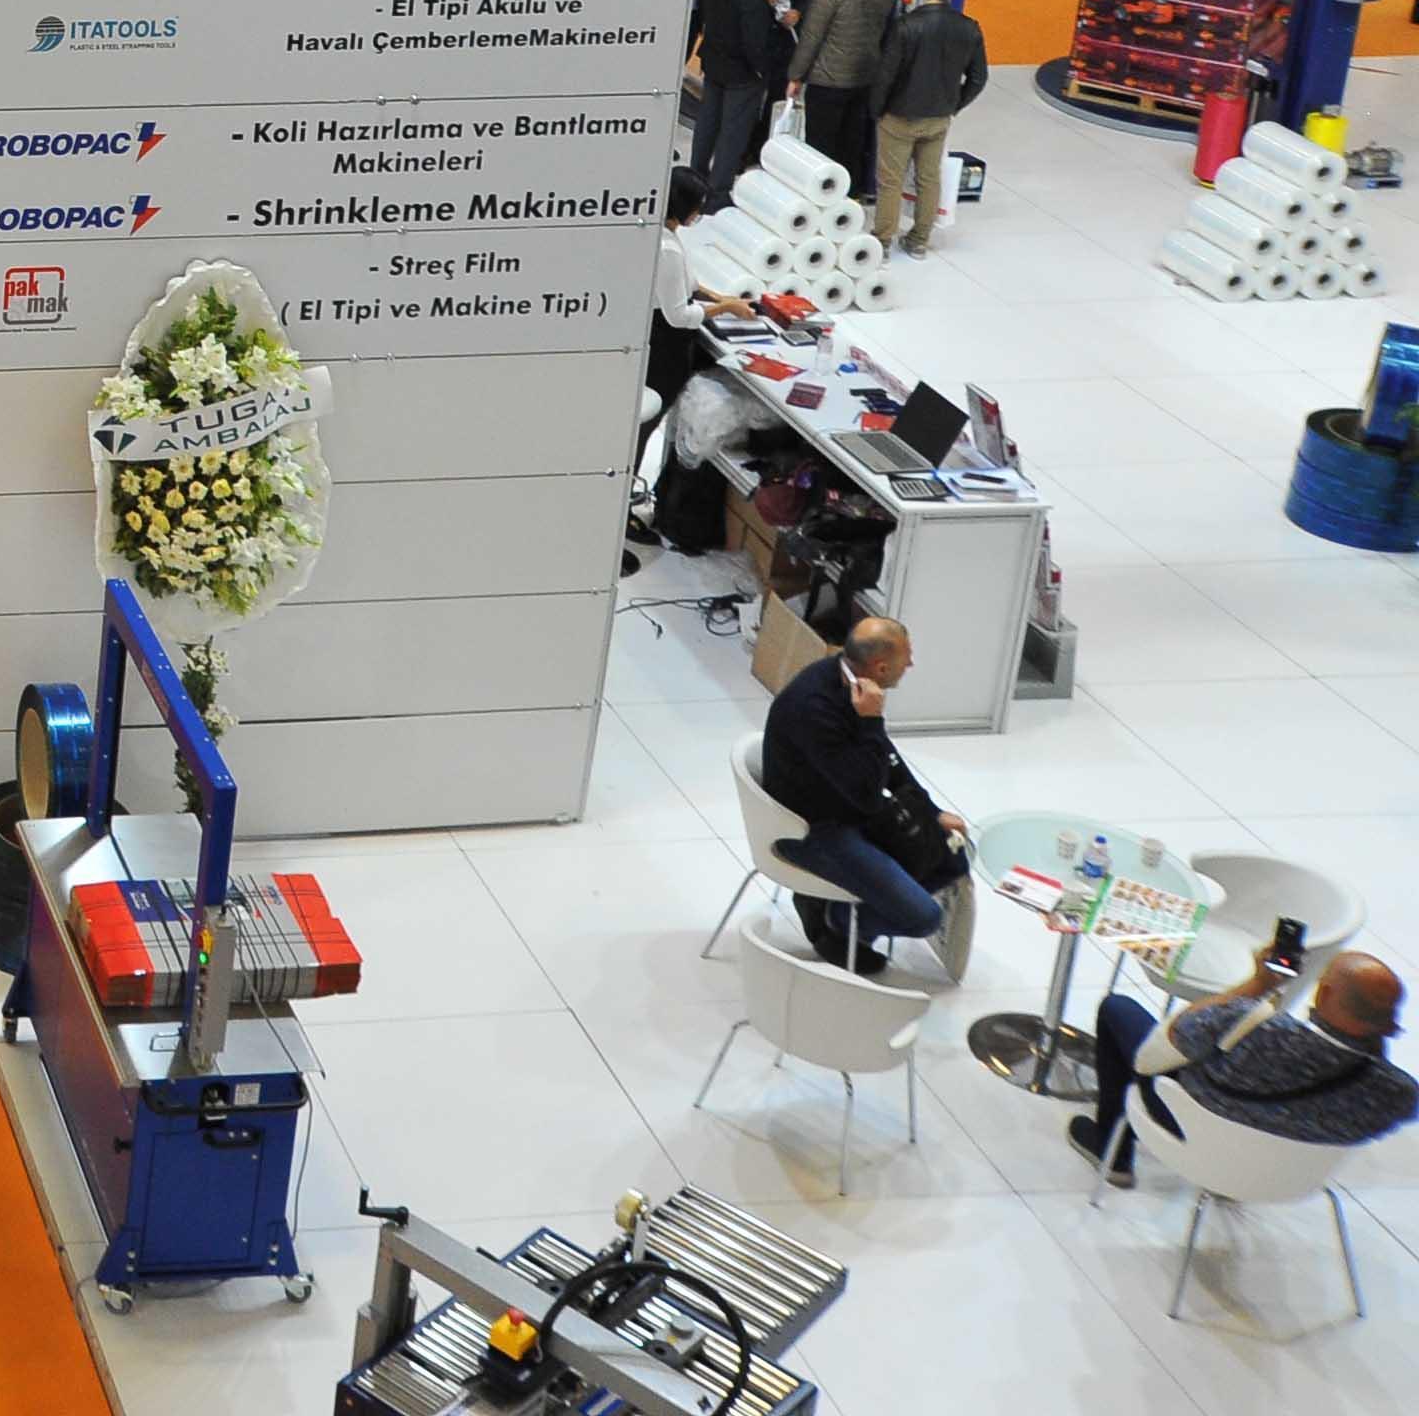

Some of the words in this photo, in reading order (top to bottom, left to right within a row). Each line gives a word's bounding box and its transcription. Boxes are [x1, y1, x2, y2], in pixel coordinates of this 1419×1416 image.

[391, 0, 416, 18] El
[422, 0, 470, 22] Tipi
[555, 0, 583, 15] ve
[69, 18, 177, 41] ITATOOLS
[286, 30, 364, 53] Havalı
[372, 25, 657, 55] ÇemberlemeMakineleri
[252, 119, 310, 146] Koli
[316, 117, 463, 143] Hazırlama
[473, 124, 505, 140] ve
[513, 114, 647, 138] Bantlama
[332, 148, 484, 176] Makineleri
[253, 195, 456, 227] Shrinkleme
[467, 188, 658, 222] Makineleri
[389, 254, 456, 283] Streç
[464, 252, 521, 276] Film
[4, 272, 39, 299] pak
[26, 288, 69, 315] mak
[300, 300, 324, 322] El
[332, 299, 384, 325] Tipi
[390, 303, 424, 319] ve
[435, 294, 532, 319] Makine
[541, 292, 590, 318] Tipi
[154, 397, 311, 454] AMBALAJ
[159, 388, 291, 434] TUGA
